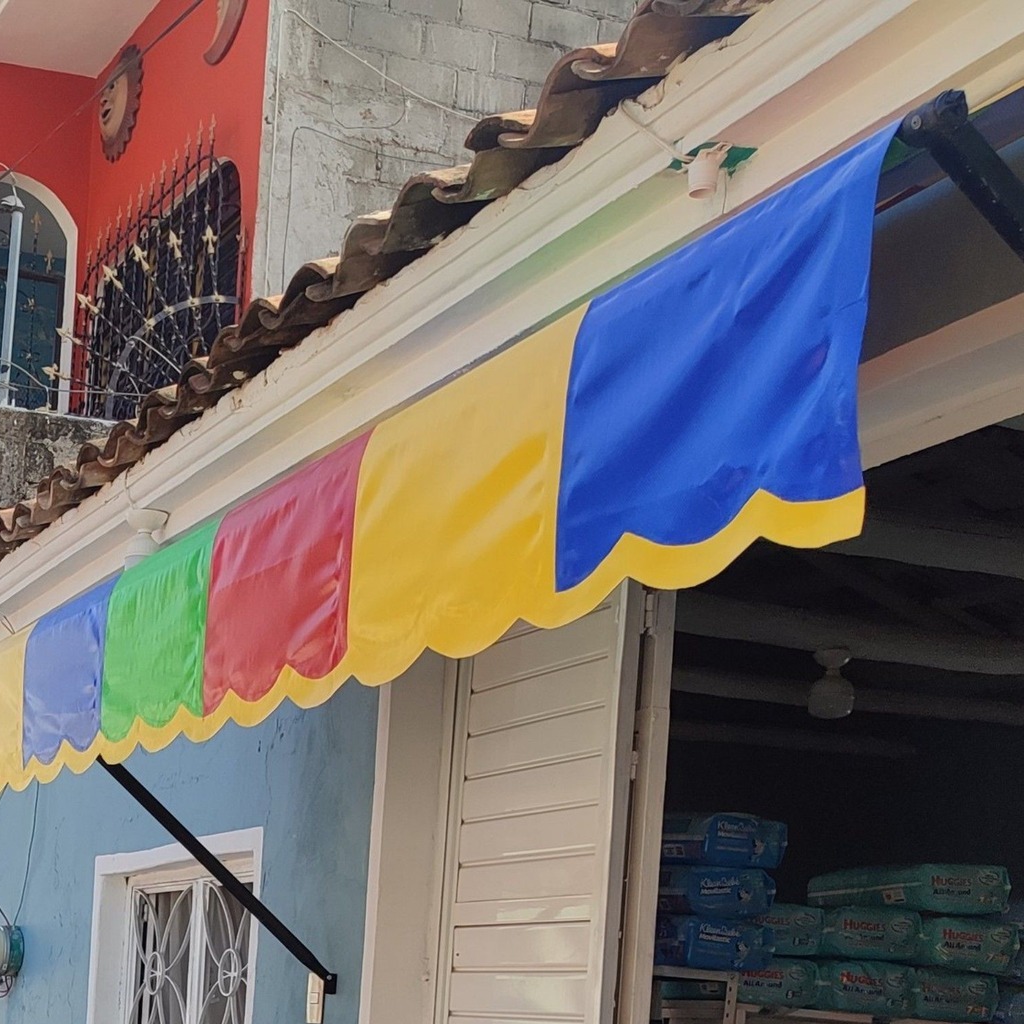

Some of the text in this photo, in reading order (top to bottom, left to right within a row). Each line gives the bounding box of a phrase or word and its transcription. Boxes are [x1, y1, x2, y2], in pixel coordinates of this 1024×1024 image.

[931, 875, 972, 887] HUGGIES
[843, 918, 886, 931] HUGGIES
[943, 929, 984, 942] HUGGIES
